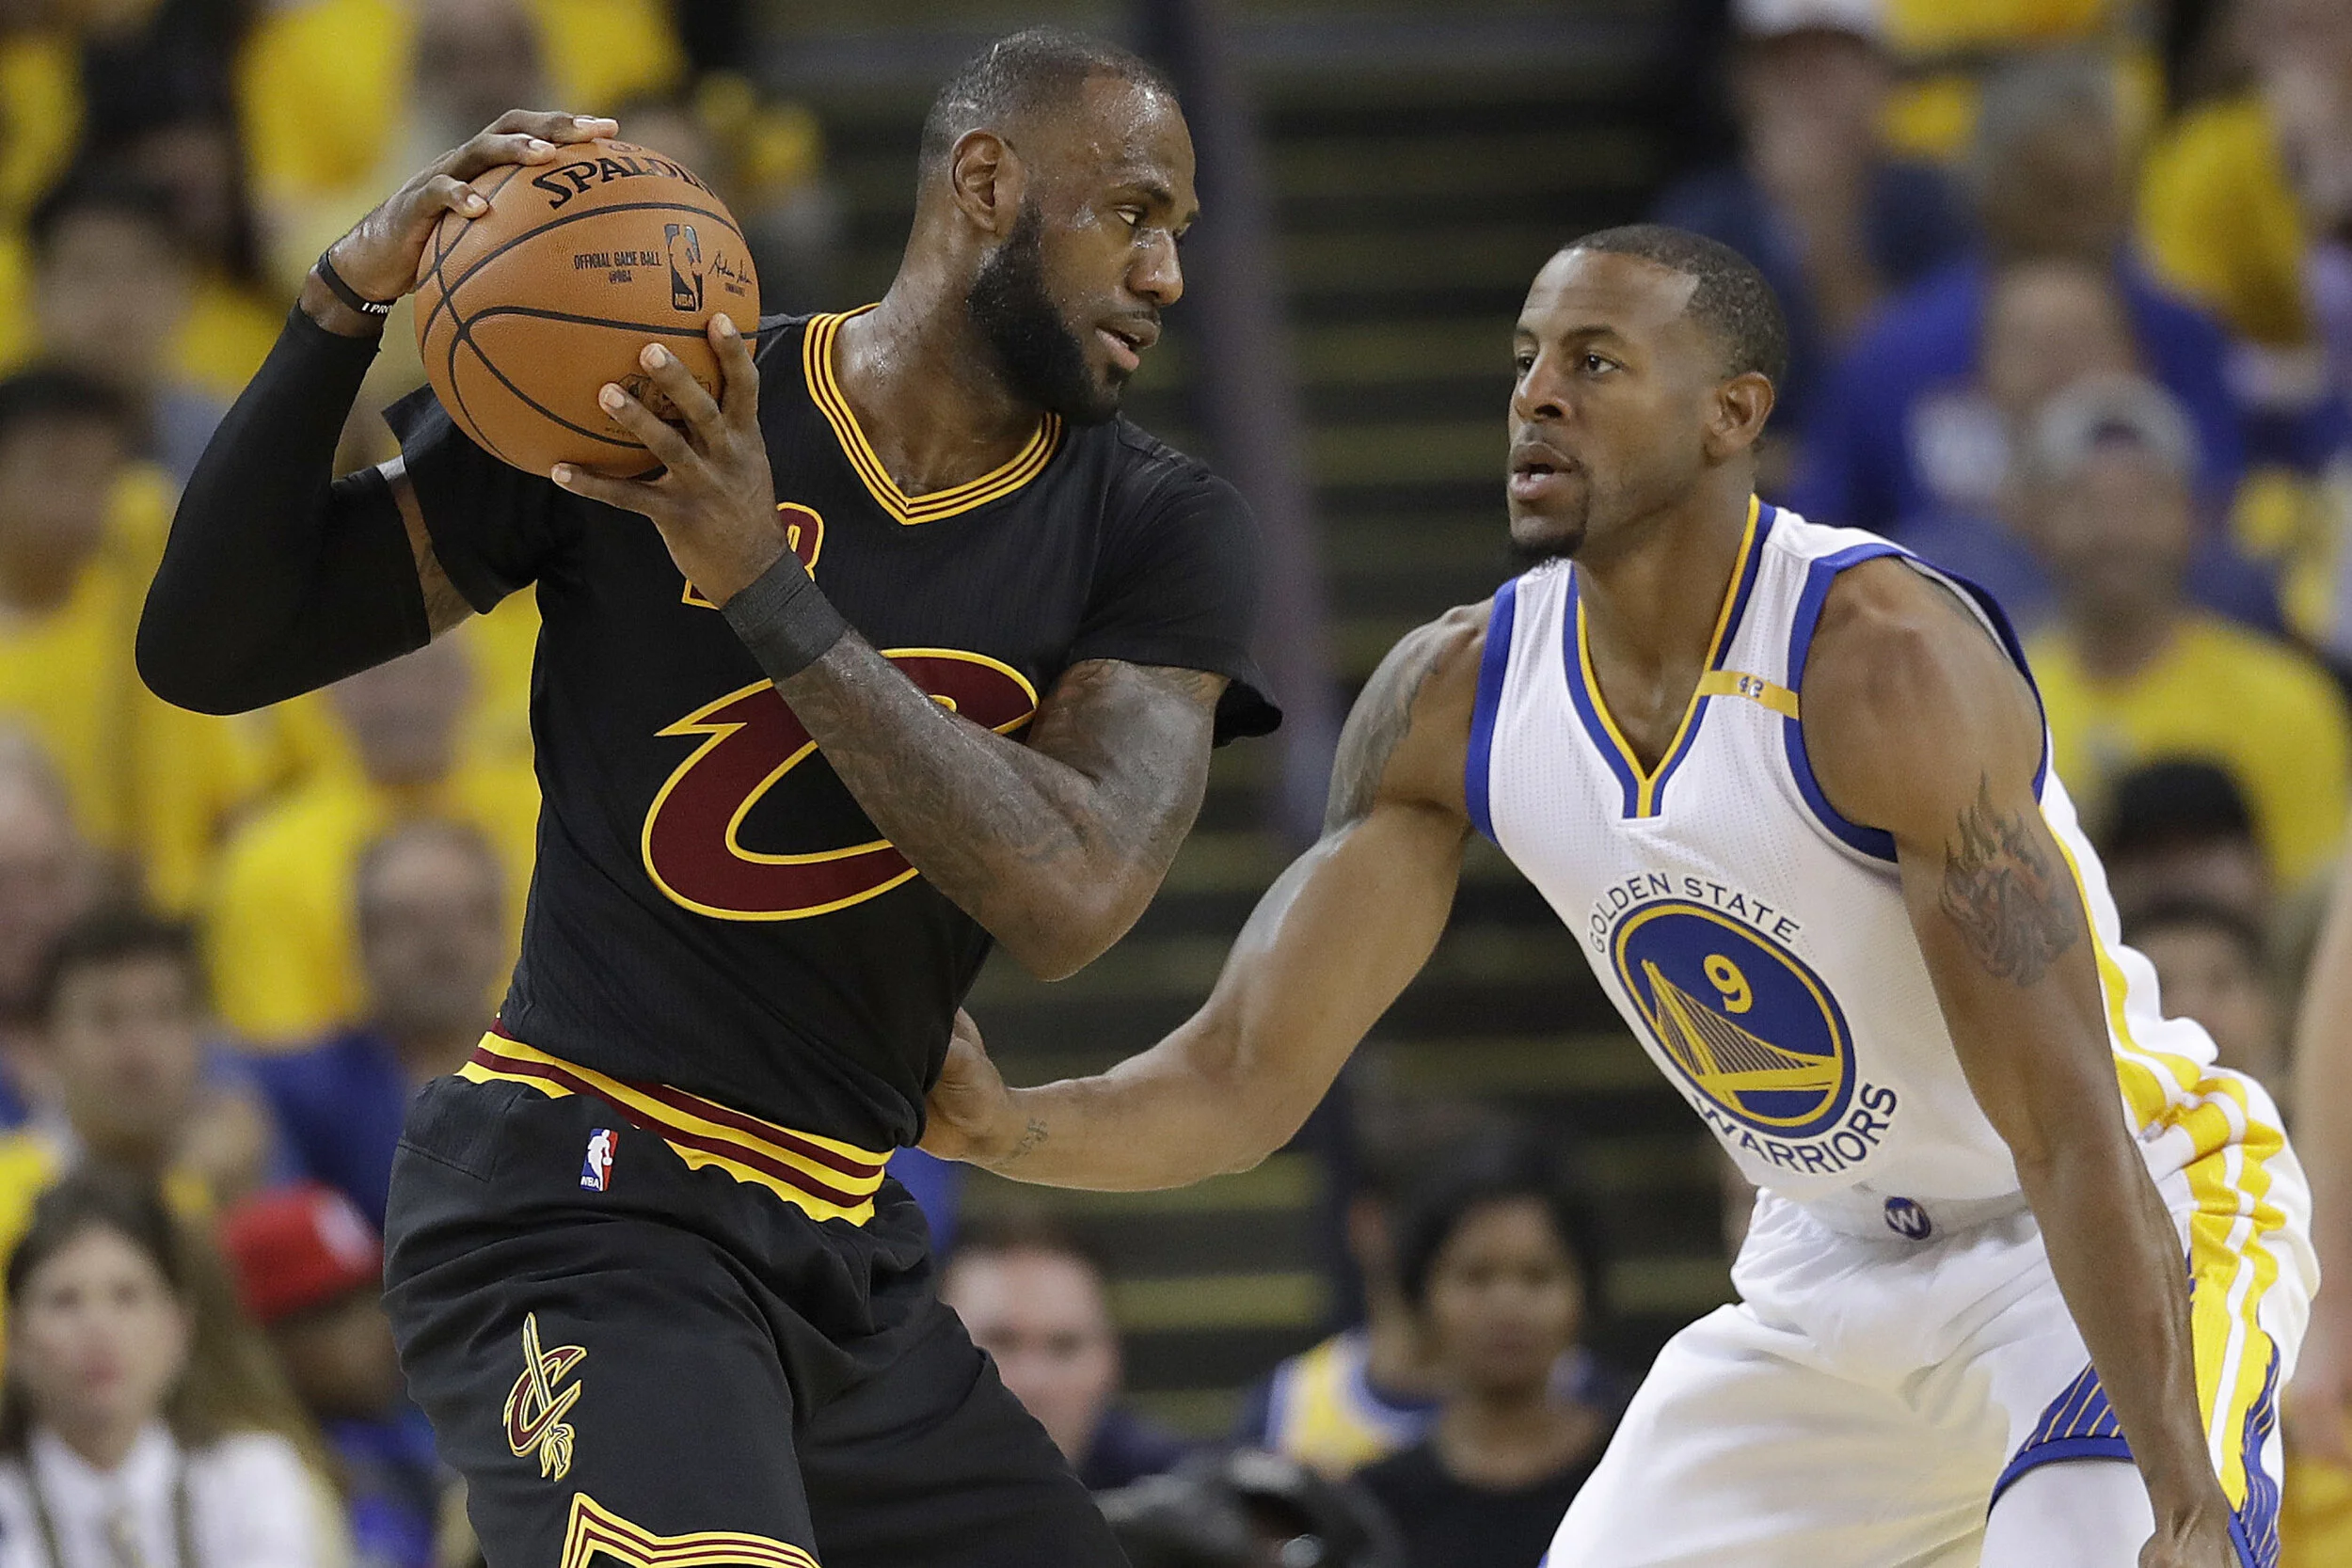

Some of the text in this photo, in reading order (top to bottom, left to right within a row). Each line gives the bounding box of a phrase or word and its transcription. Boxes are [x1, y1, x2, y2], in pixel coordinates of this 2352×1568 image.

[574, 250, 662, 270] OFFICIAL GAME BALL
[675, 293, 694, 308] NBA
[1739, 675, 1765, 699] 42
[1588, 872, 1801, 954] GOLDEN STATE
[1703, 954, 1754, 1014] 9
[1692, 1083, 1897, 1174] WARRIORS
[580, 1176, 601, 1189] NBA
[1887, 1208, 1923, 1231] W
